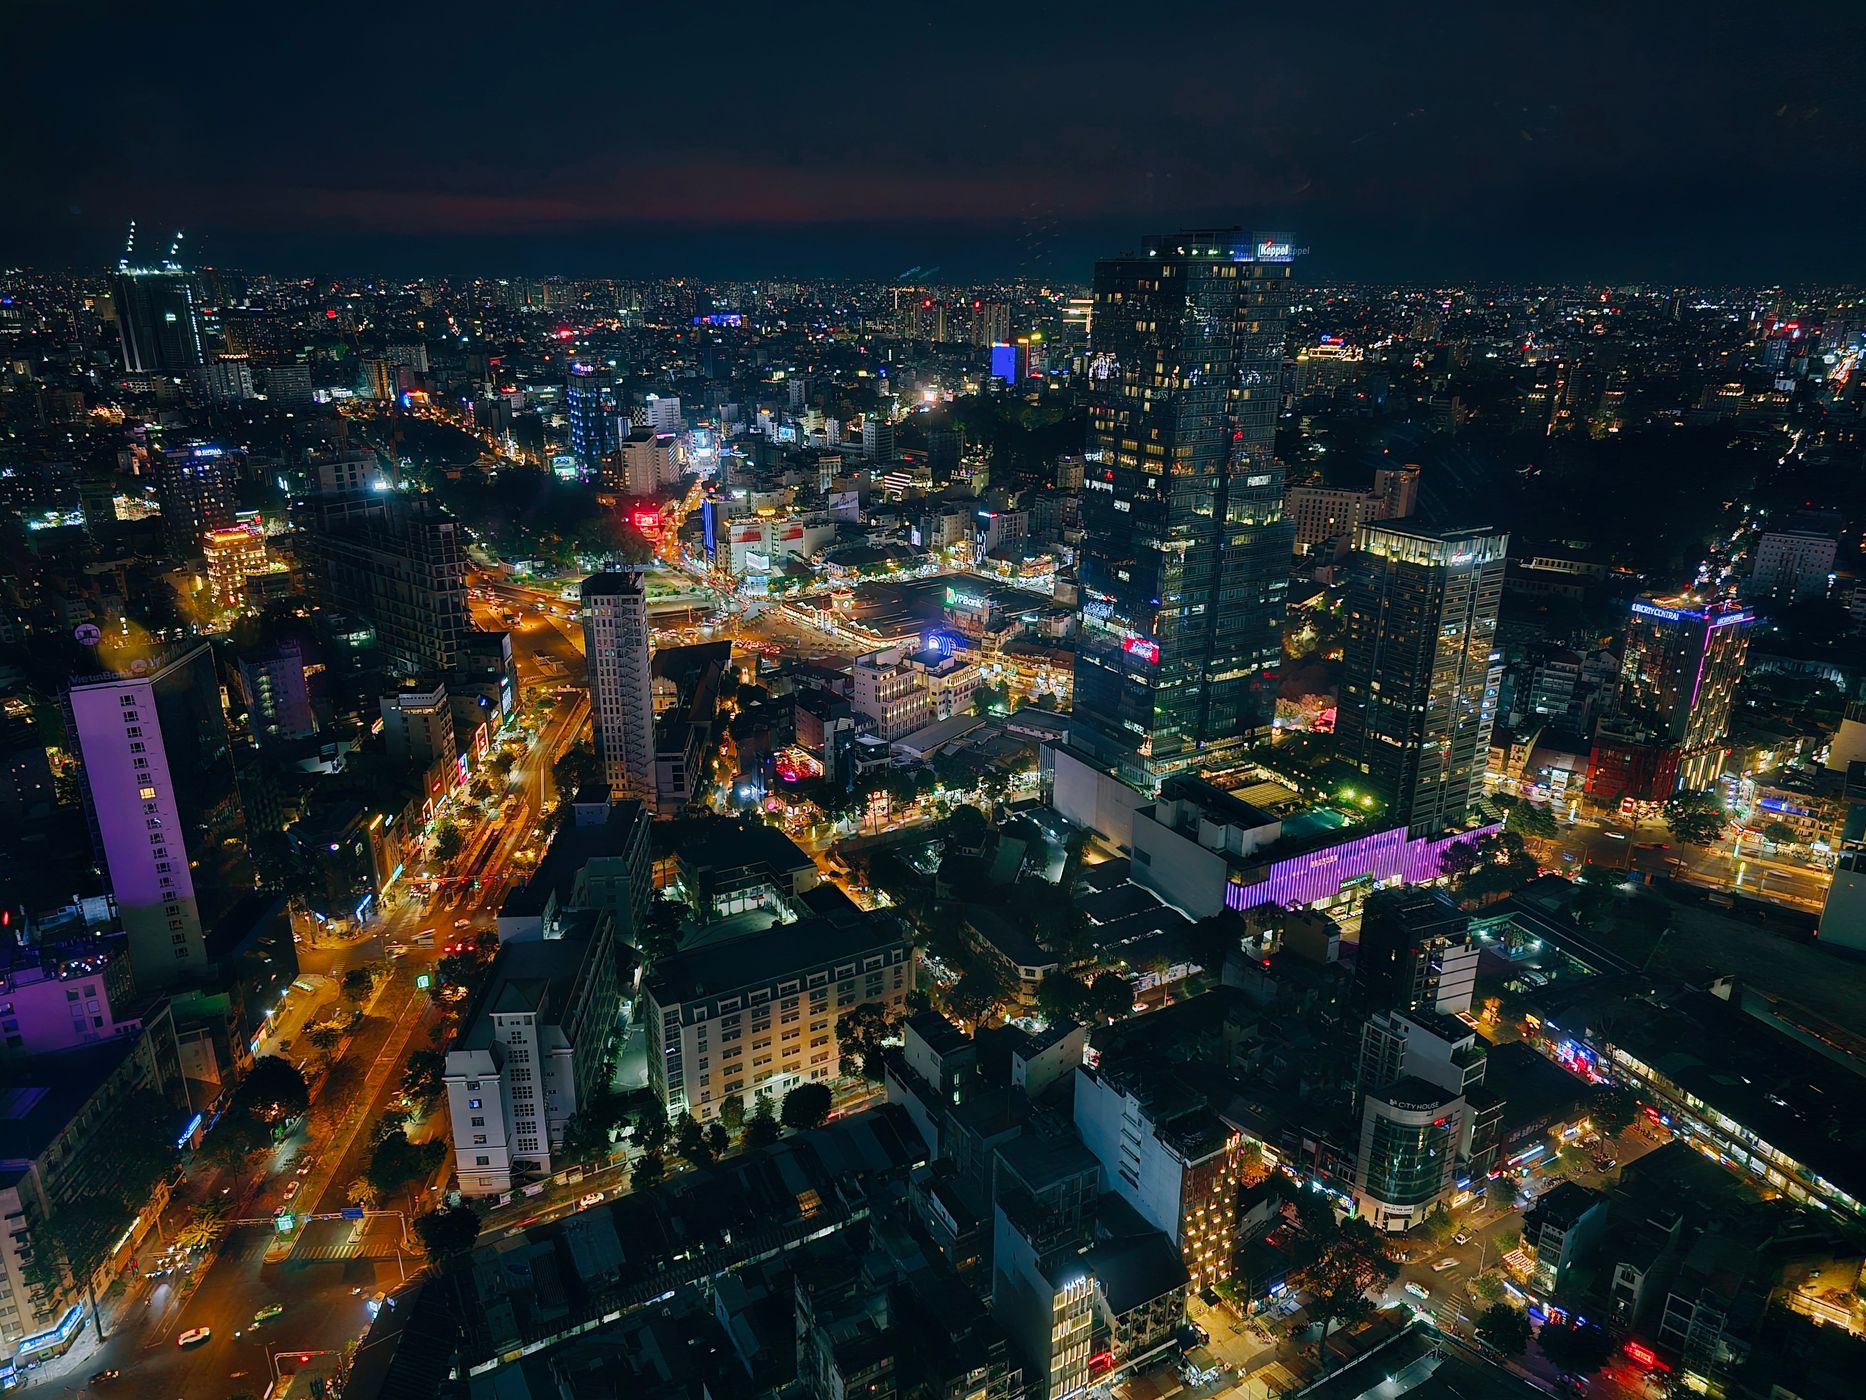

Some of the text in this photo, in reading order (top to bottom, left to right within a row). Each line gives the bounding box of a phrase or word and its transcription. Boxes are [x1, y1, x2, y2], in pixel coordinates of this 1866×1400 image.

[1260, 244, 1289, 258] Keppel
[954, 594, 983, 608] VPBank
[1399, 1101, 1440, 1111] CITY HOUSE
